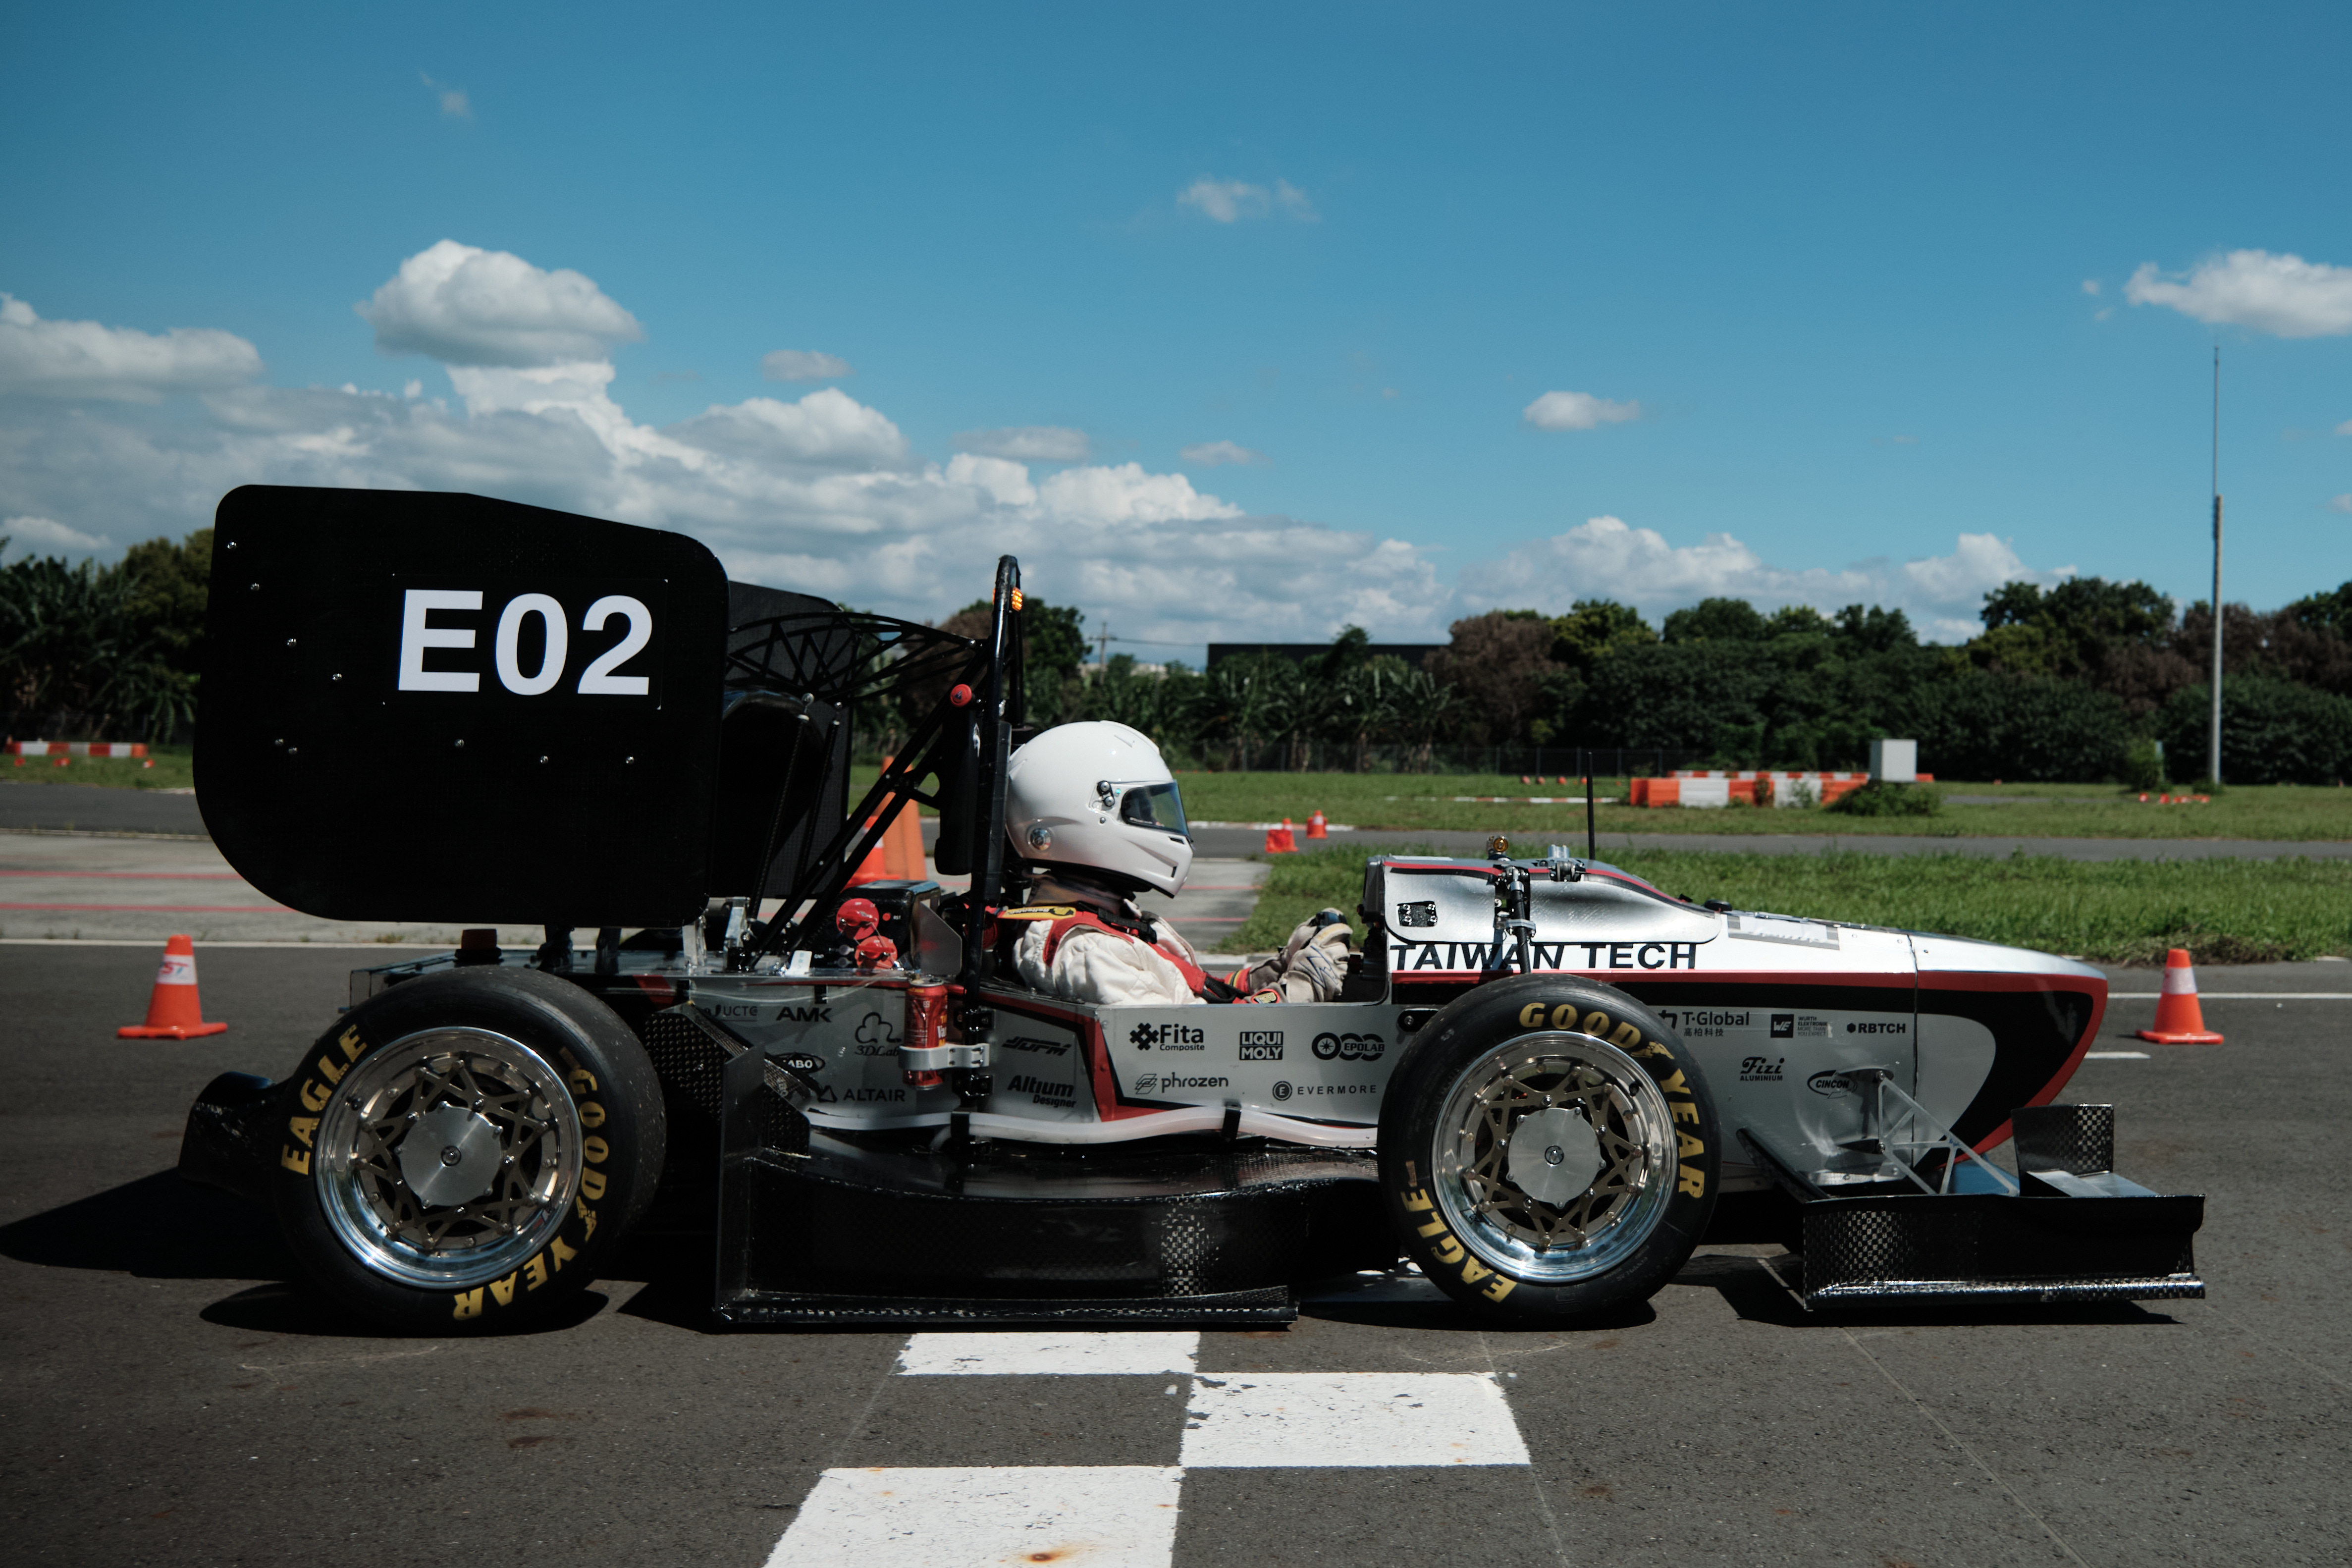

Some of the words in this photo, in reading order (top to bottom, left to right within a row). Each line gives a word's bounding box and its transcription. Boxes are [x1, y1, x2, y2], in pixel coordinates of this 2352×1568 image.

[398, 589, 652, 695] E02
[1390, 944, 1564, 970] TAIWAN
[1580, 944, 1697, 970] TECH
[776, 1006, 832, 1023] AMK
[1160, 1024, 1204, 1043] Fita
[1684, 1028, 1724, 1037] 高柏科技
[1858, 1023, 1906, 1033] RBTCH
[1241, 1032, 1282, 1046] LIQUI
[854, 1044, 900, 1057] 3DLab
[1240, 1047, 1283, 1060] MOLY
[1344, 1042, 1386, 1052] EPOLAB
[1007, 1075, 1075, 1098] Altium
[1161, 1072, 1229, 1093] phrozen
[1297, 1084, 1377, 1095] EVERMORE
[1816, 1080, 1850, 1088] CINCON
[281, 1024, 368, 1175] EAGLE
[843, 1089, 906, 1102] ALTAIR
[1032, 1094, 1077, 1108] Designer
[1400, 1189, 1517, 1302] EAGLE
